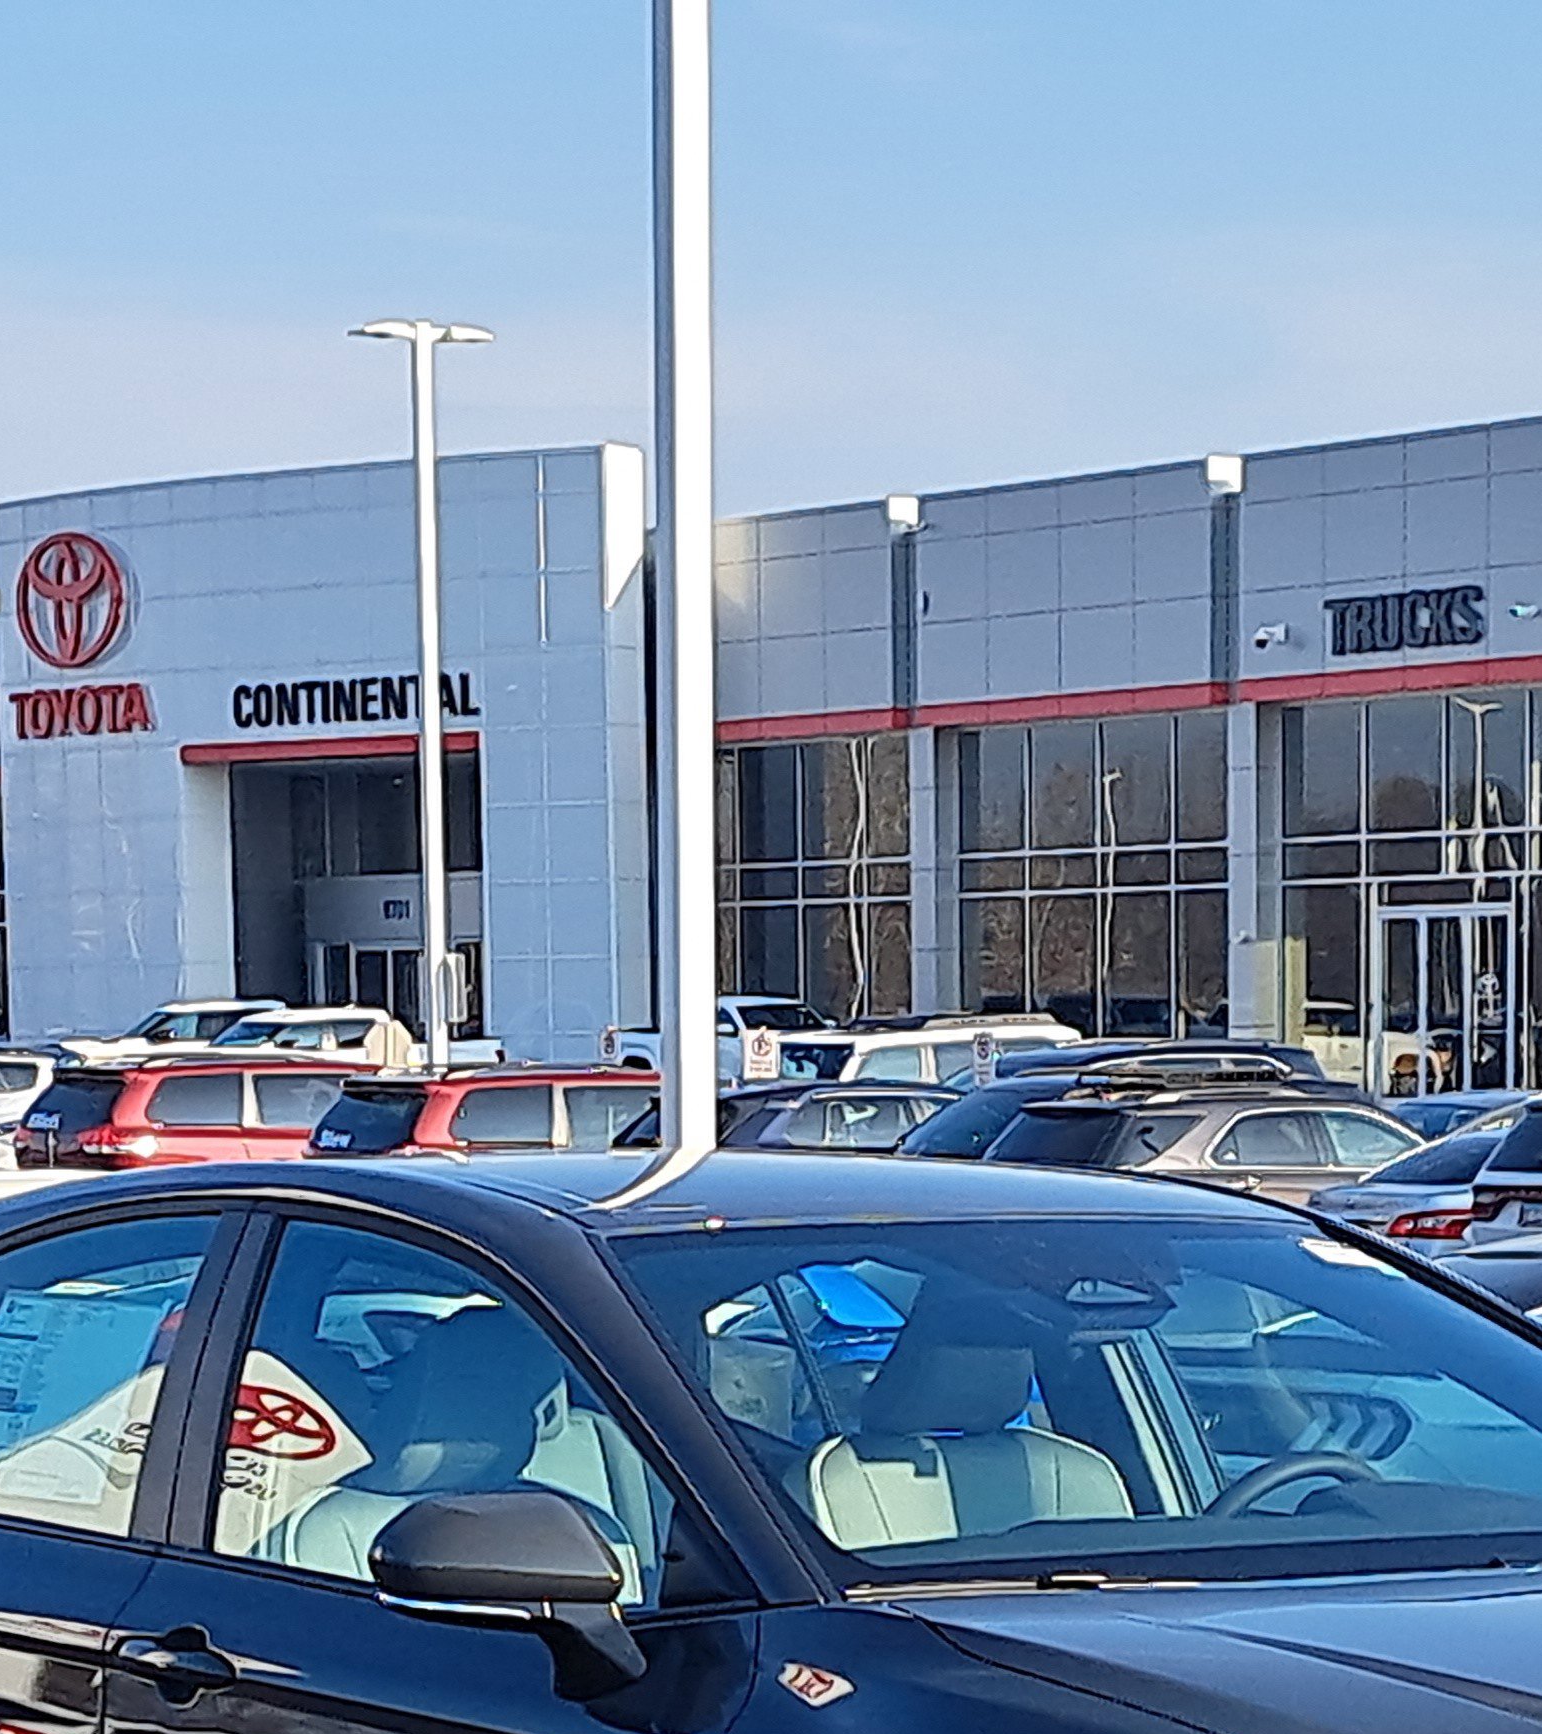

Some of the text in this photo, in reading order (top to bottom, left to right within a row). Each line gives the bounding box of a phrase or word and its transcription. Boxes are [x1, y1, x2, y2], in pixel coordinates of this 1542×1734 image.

[1324, 585, 1484, 656] TRUCKS
[9, 683, 152, 740] TOYOTA
[232, 673, 481, 728] CONTINENTAL
